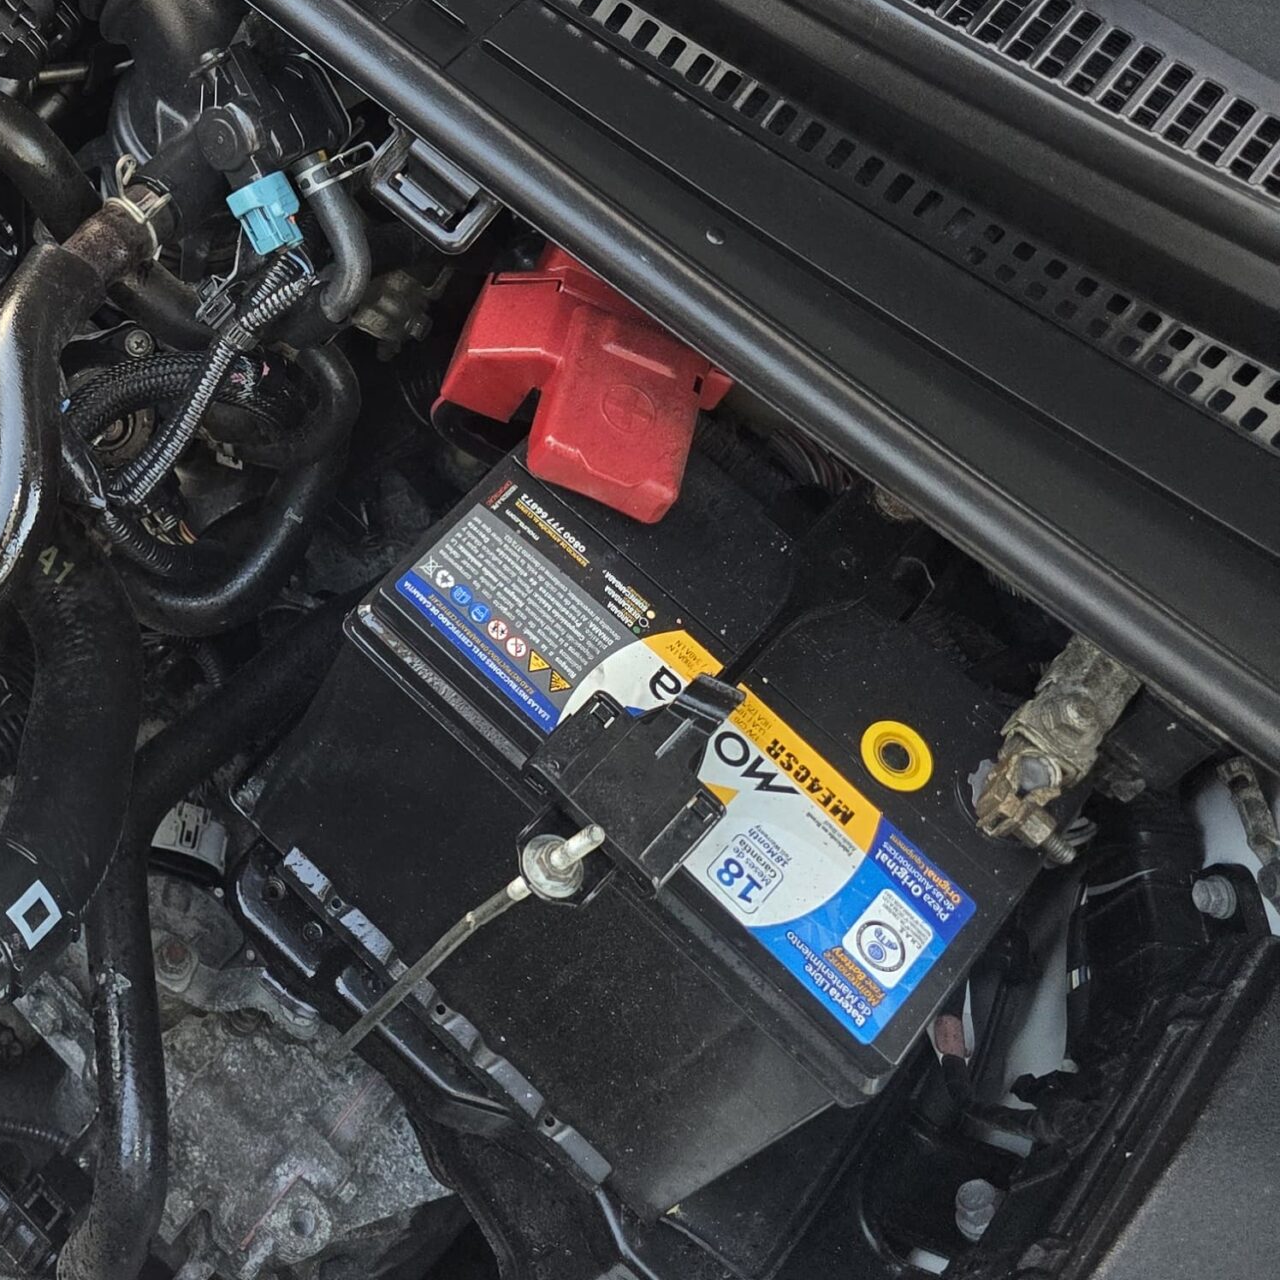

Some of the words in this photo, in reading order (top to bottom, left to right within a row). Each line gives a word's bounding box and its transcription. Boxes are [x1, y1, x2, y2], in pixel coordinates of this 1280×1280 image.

[729, 845, 746, 861] de
[735, 838, 779, 880] Garantía
[879, 840, 933, 891] Automotrices
[715, 857, 764, 904] 18
[742, 857, 772, 886] Meses
[871, 845, 926, 898] Original
[918, 892, 950, 922] Pieza
[929, 887, 945, 902] las
[940, 897, 956, 912] de
[783, 929, 859, 1004] Mantenimiento
[801, 961, 831, 991] Libre
[825, 985, 867, 1027] Batería
[854, 999, 873, 1017] de
